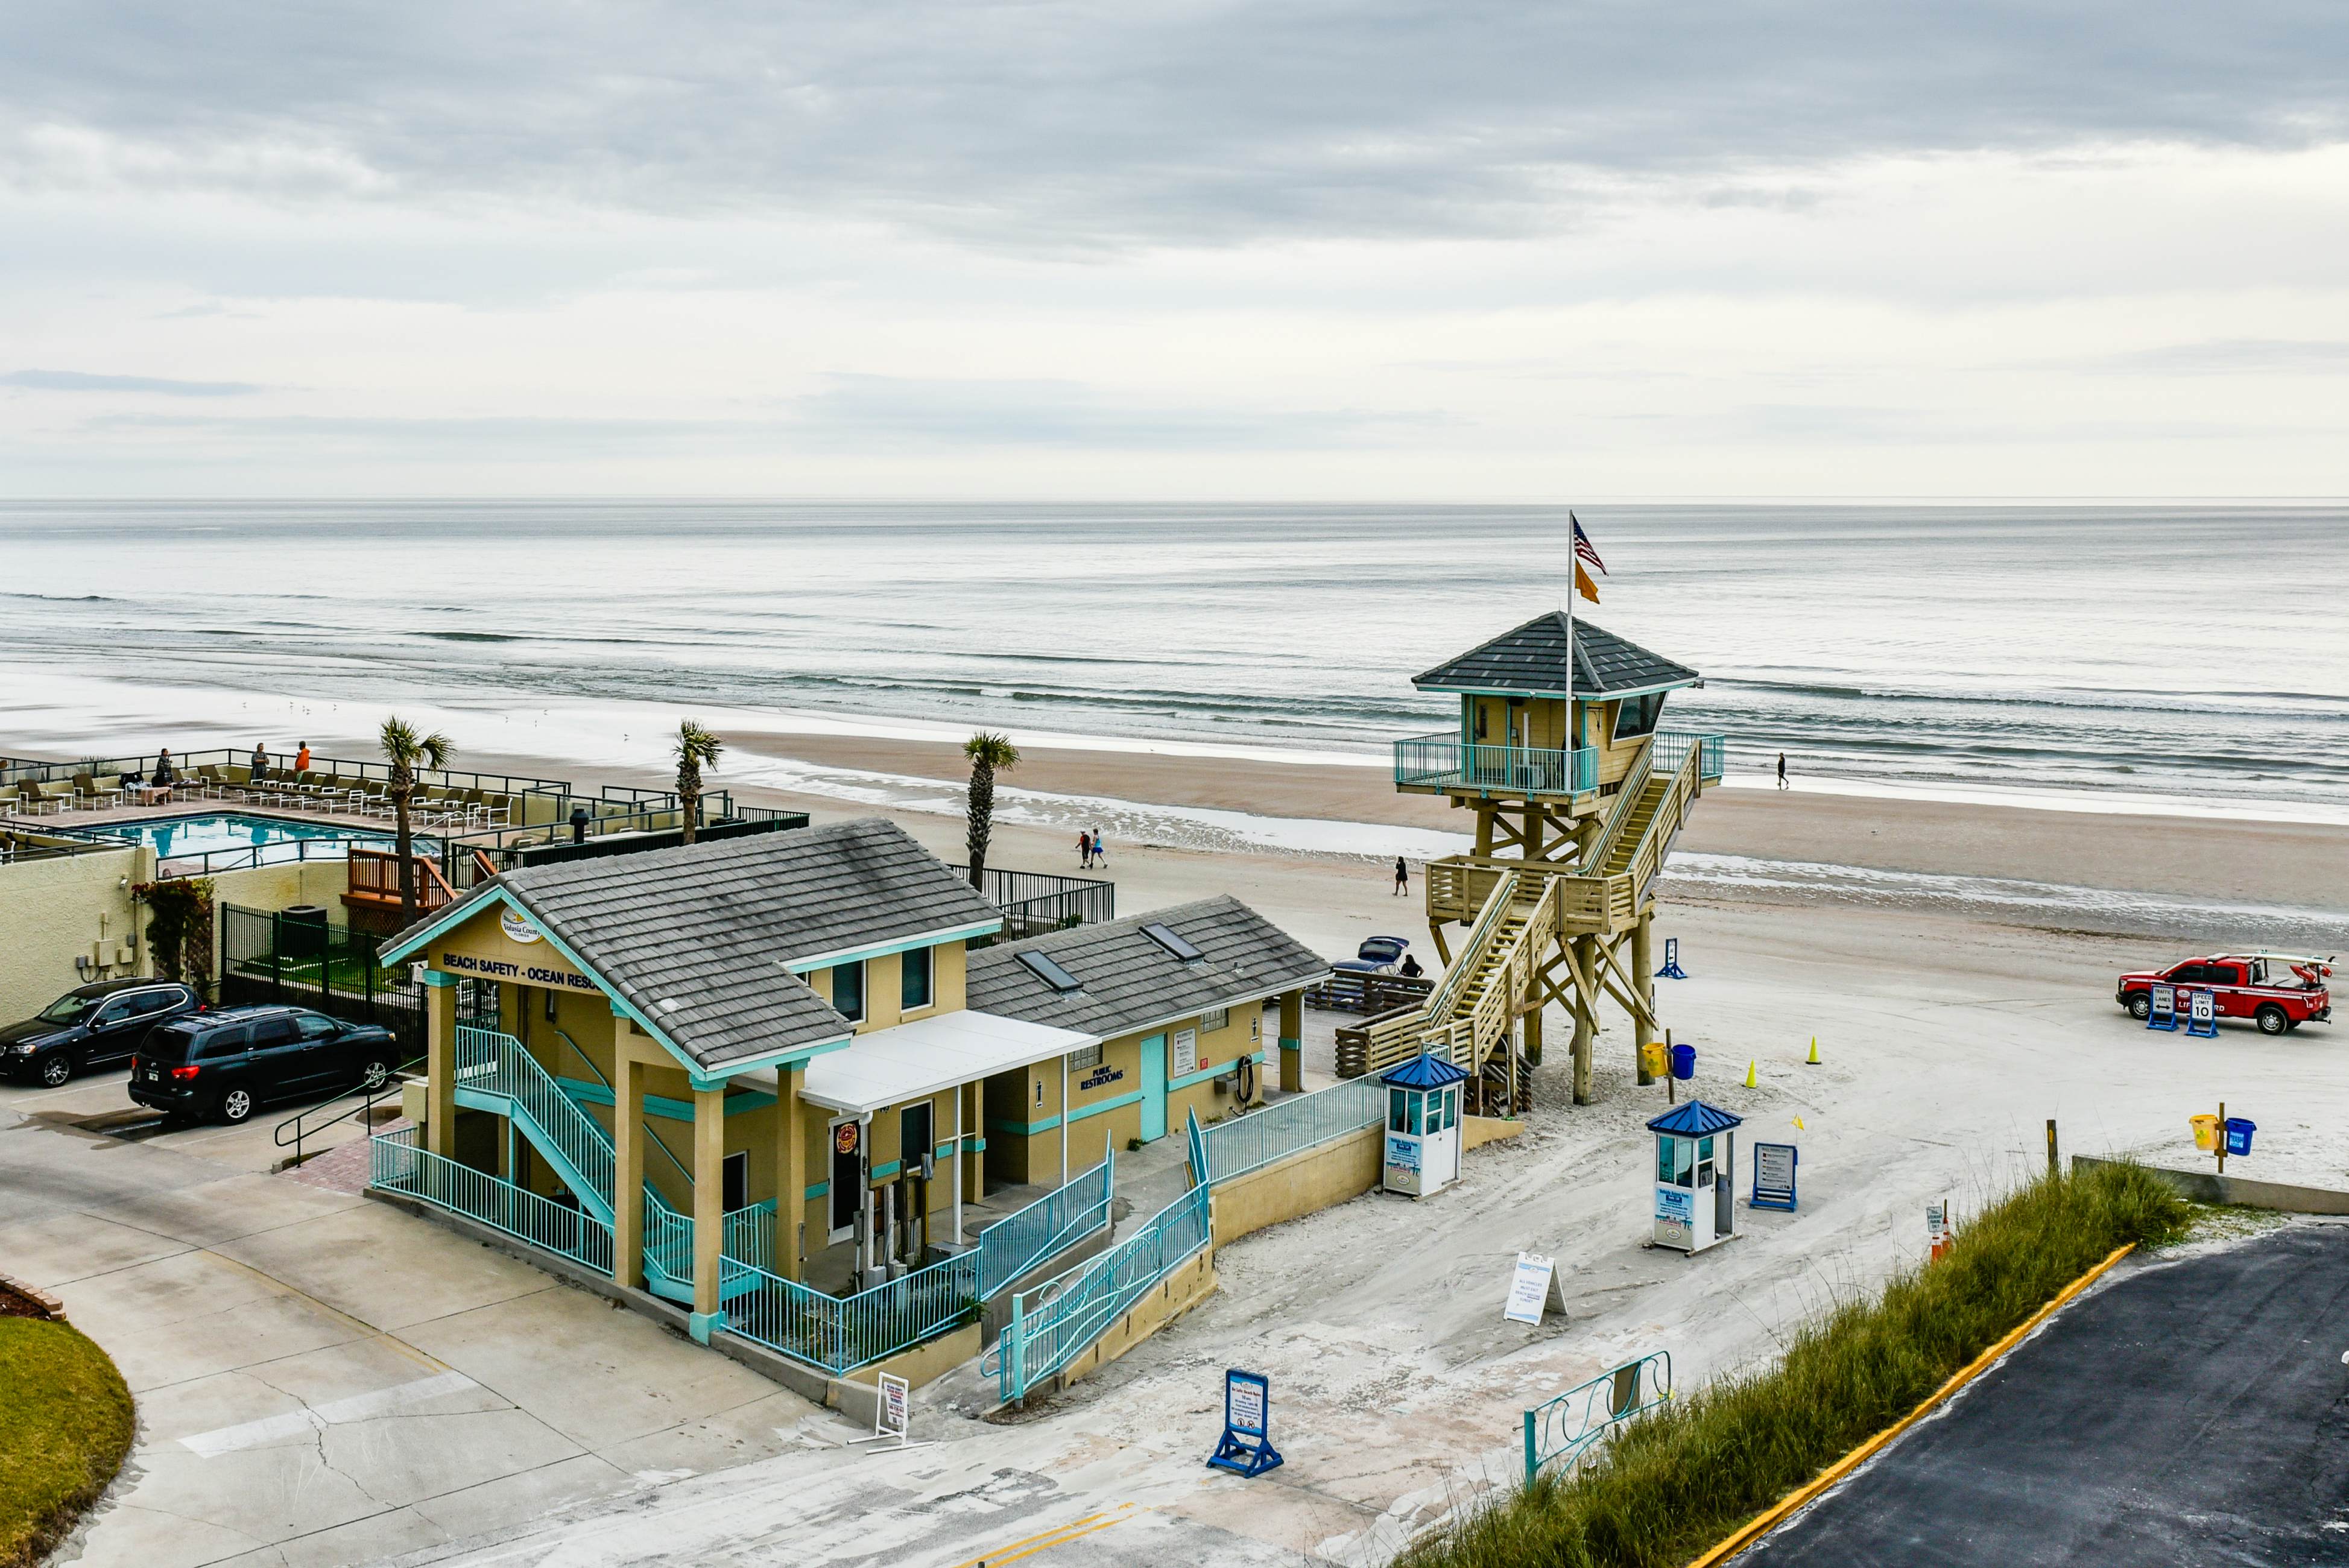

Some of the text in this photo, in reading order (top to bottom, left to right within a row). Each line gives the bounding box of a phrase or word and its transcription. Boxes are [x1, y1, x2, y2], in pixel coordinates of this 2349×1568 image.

[504, 923, 540, 937] Volusia County
[443, 953, 477, 970] BEACH
[479, 959, 519, 977] SAFETY
[528, 967, 564, 984] OCEAN
[567, 973, 602, 990] RESC
[2196, 1006, 2209, 1017] 10
[1093, 1065, 1111, 1077] PUBLIC
[1080, 1069, 1124, 1091] RESTROOMS
